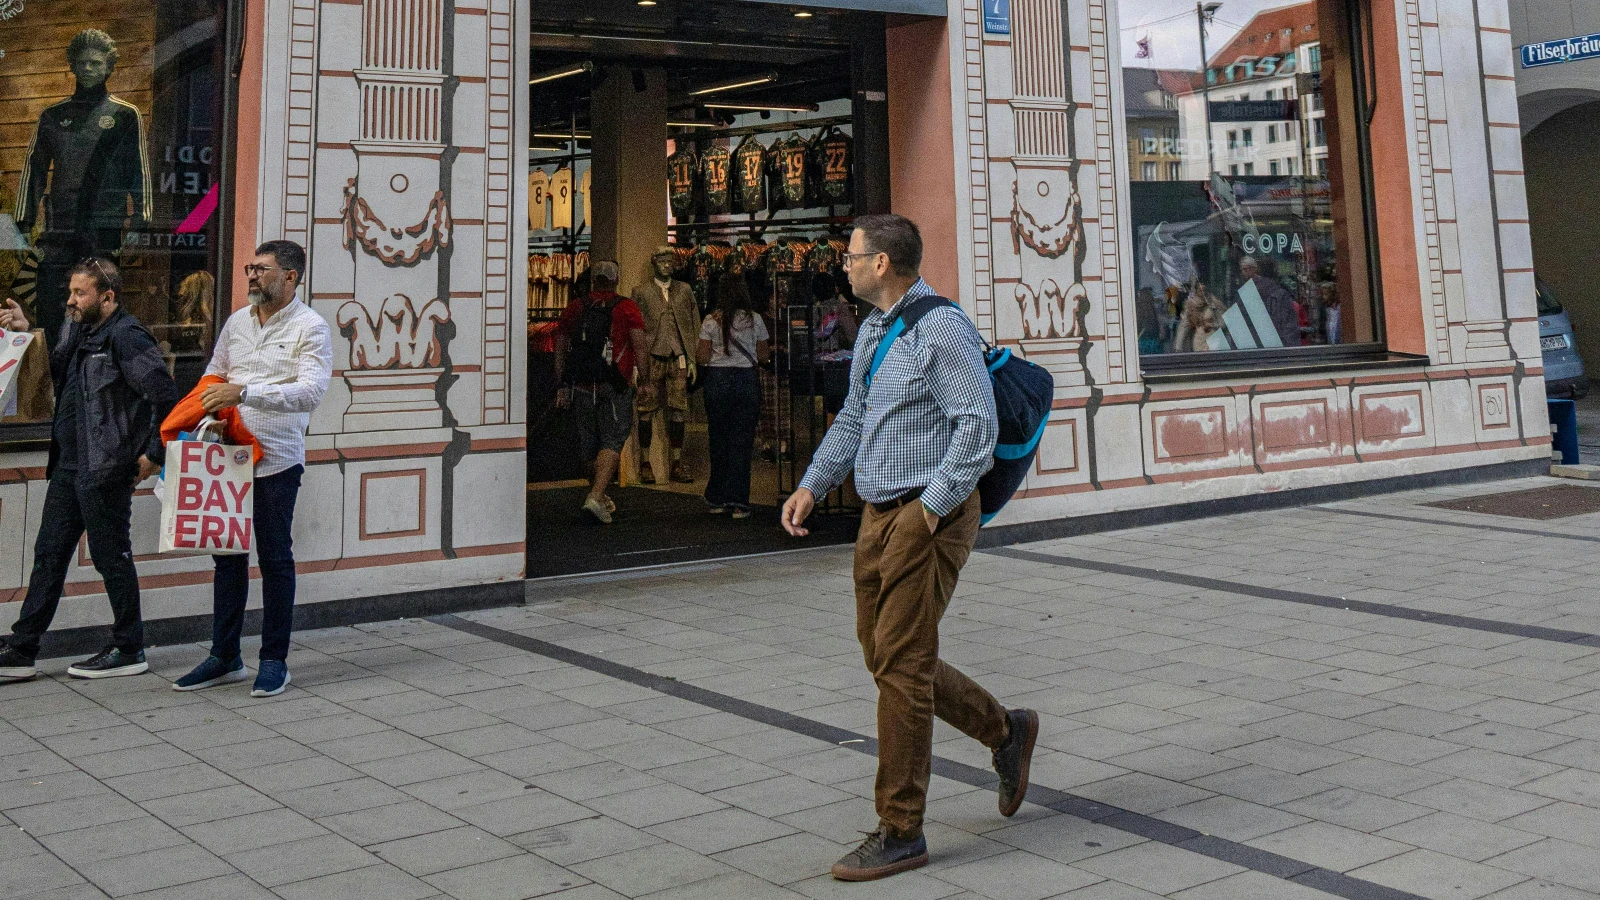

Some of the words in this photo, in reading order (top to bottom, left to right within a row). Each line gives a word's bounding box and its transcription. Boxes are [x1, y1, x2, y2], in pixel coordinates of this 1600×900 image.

[1528, 37, 1600, 62] Filserbräu
[709, 161, 726, 184] 16
[744, 156, 760, 180] 17
[786, 153, 803, 178] 19
[826, 149, 847, 173] 22
[674, 164, 691, 186] 11
[535, 186, 542, 205] 8
[560, 185, 568, 204] 9
[1242, 232, 1304, 254] COPA
[180, 441, 225, 476] FC
[177, 477, 252, 514] BAY
[174, 514, 252, 551] ERN
